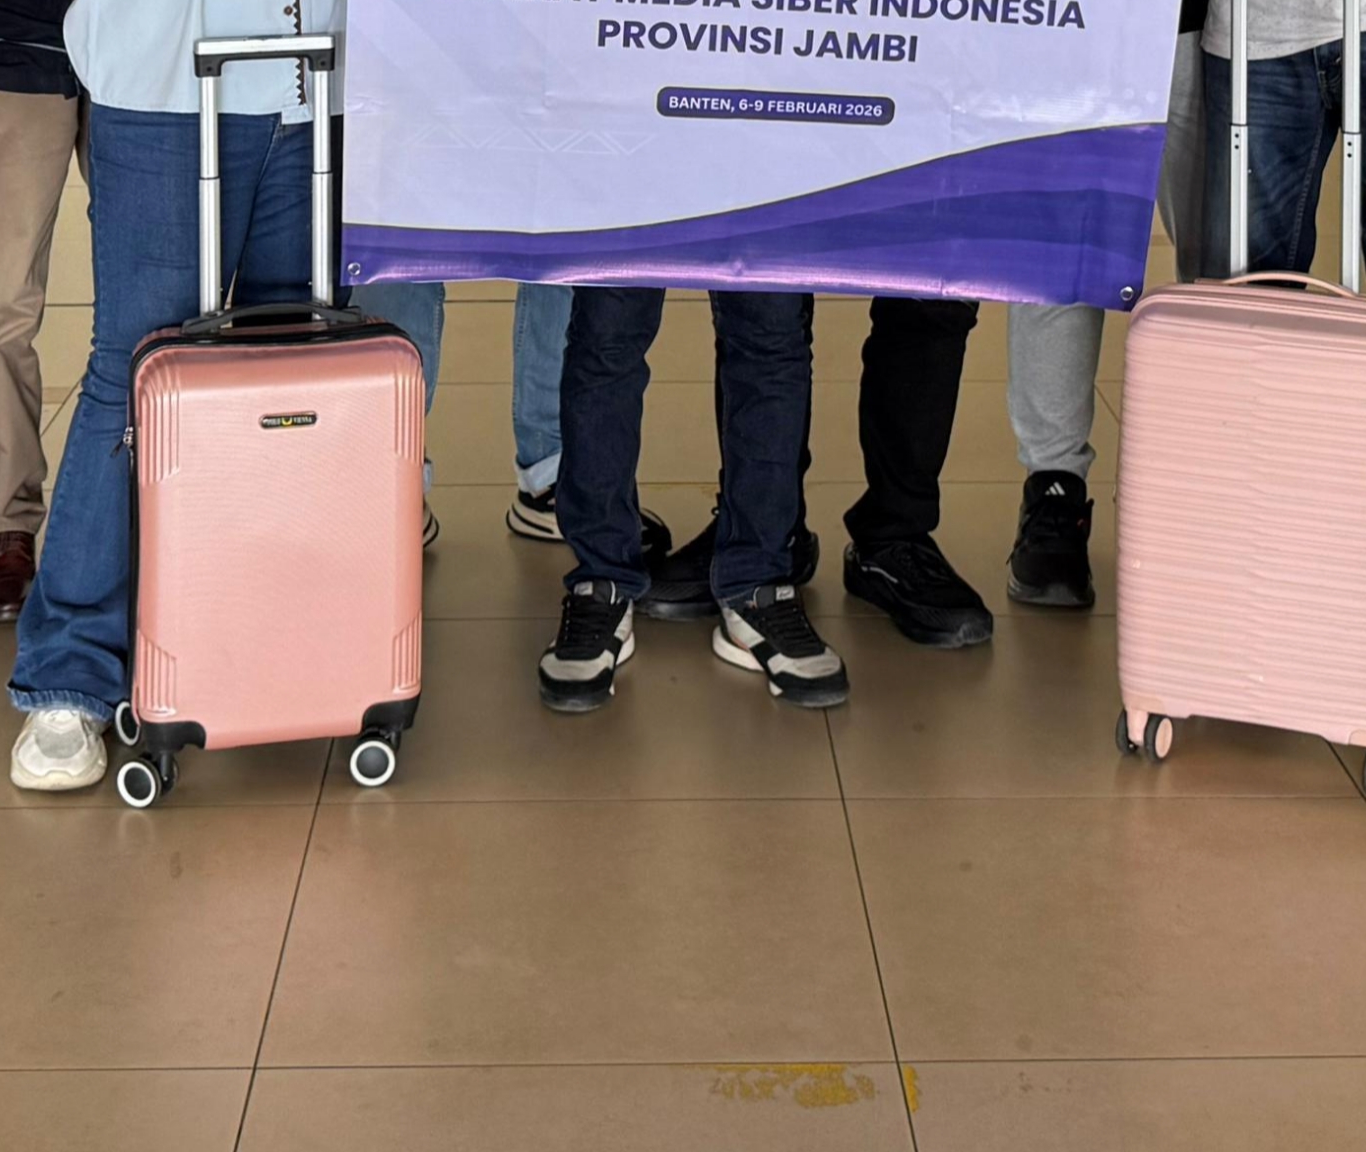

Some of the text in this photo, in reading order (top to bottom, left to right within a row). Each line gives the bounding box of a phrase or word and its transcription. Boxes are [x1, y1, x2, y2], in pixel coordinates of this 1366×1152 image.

[597, 19, 918, 62] PROVINSI JAMBI
[669, 96, 883, 117] BANTEN, 6-9 FEBRUARI 2026
